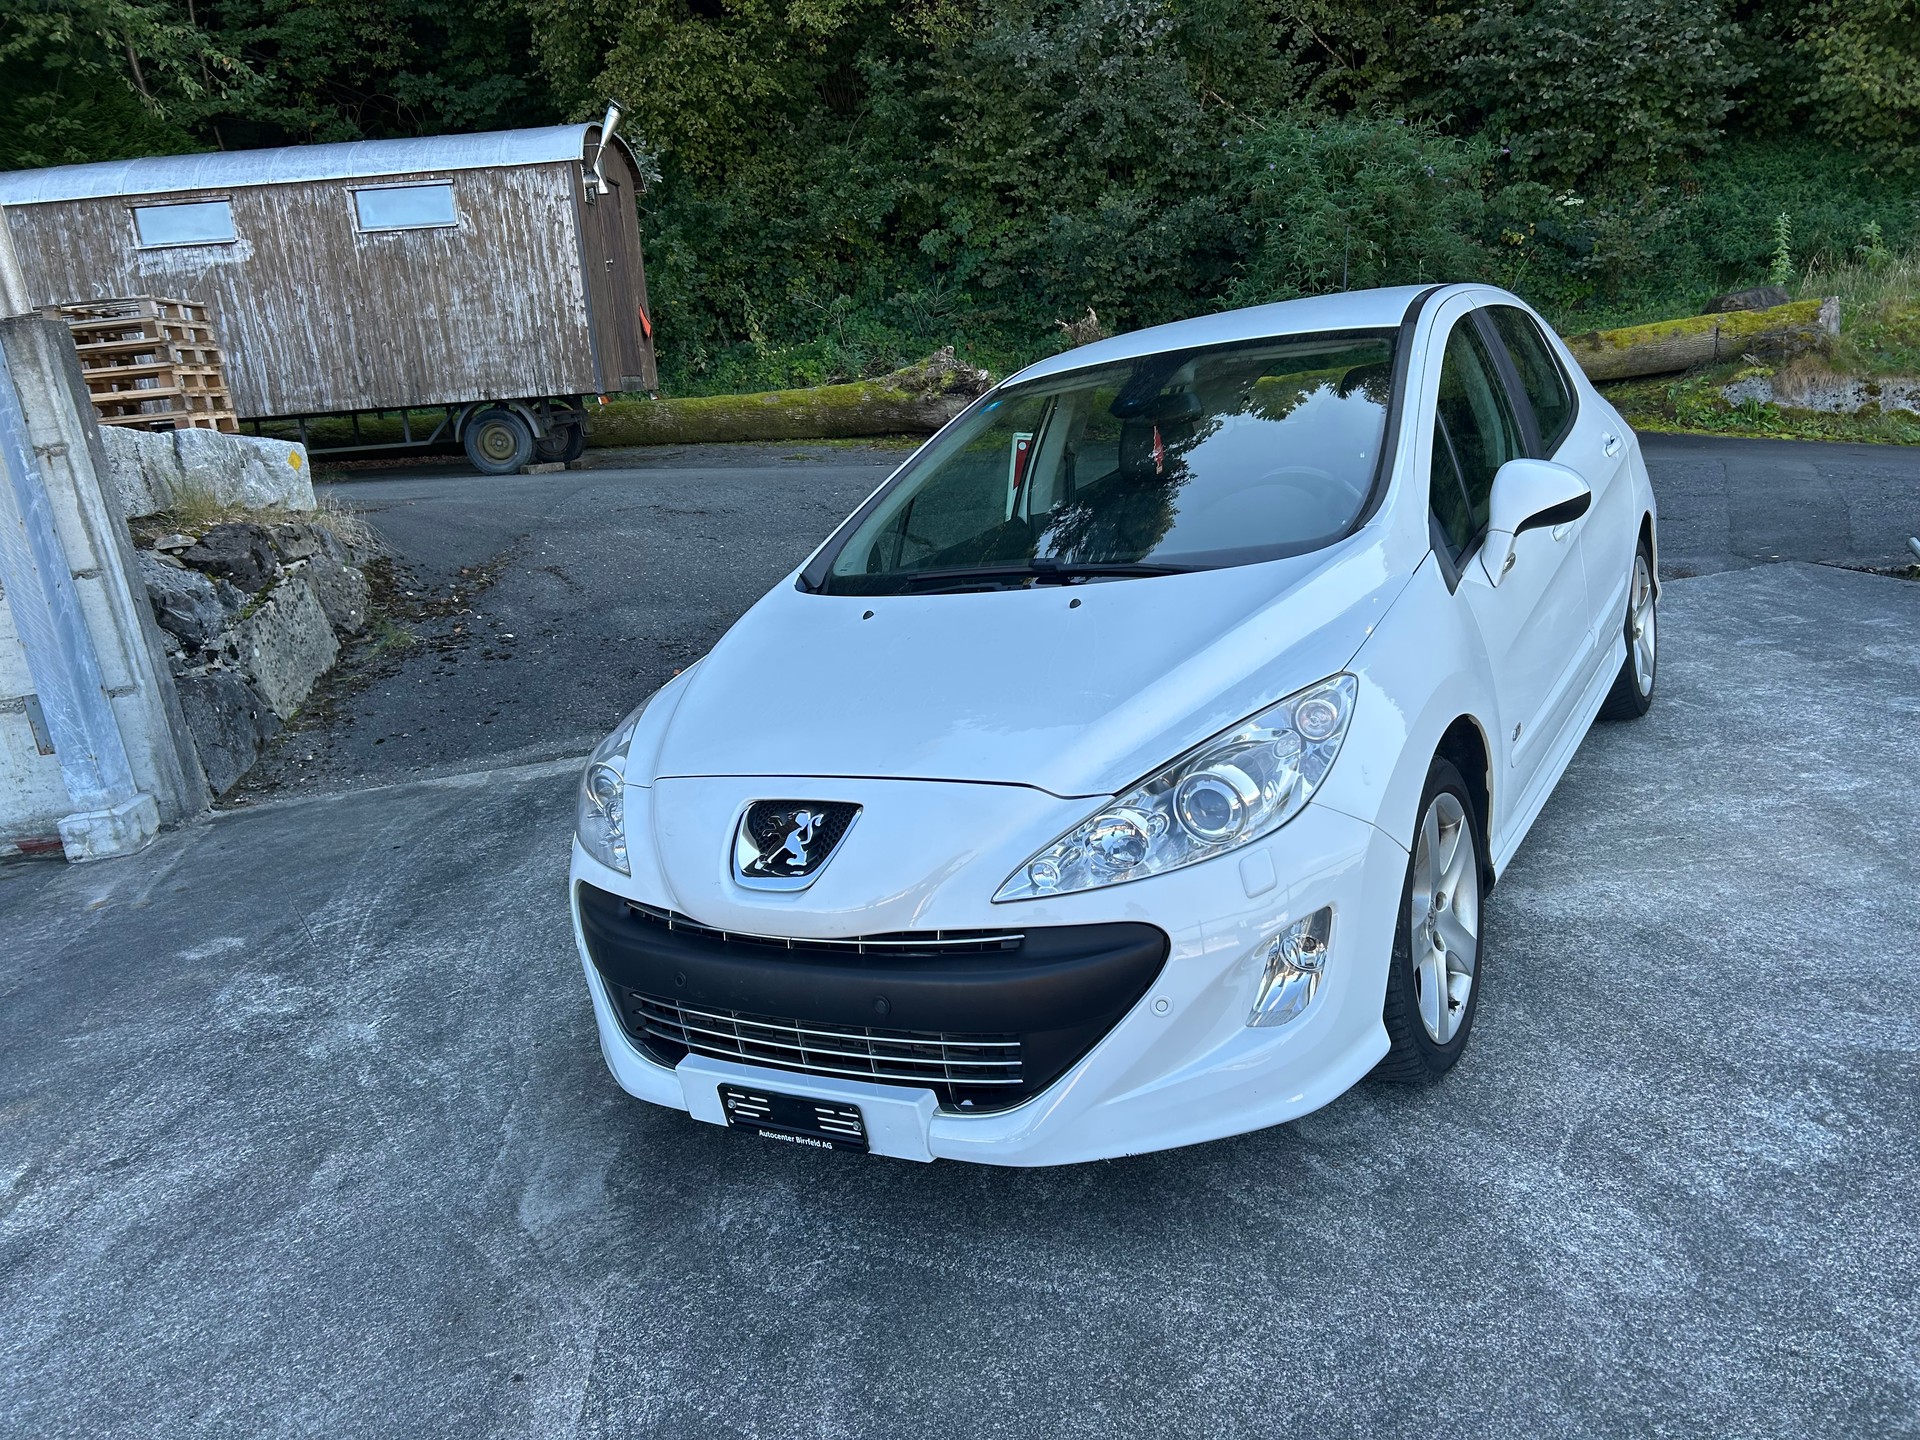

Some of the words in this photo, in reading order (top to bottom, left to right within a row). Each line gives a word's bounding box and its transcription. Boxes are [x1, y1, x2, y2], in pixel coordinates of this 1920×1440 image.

[759, 1129, 794, 1142] Autocenter
[795, 1136, 820, 1147] Birrfeld
[822, 1141, 833, 1150] AG
